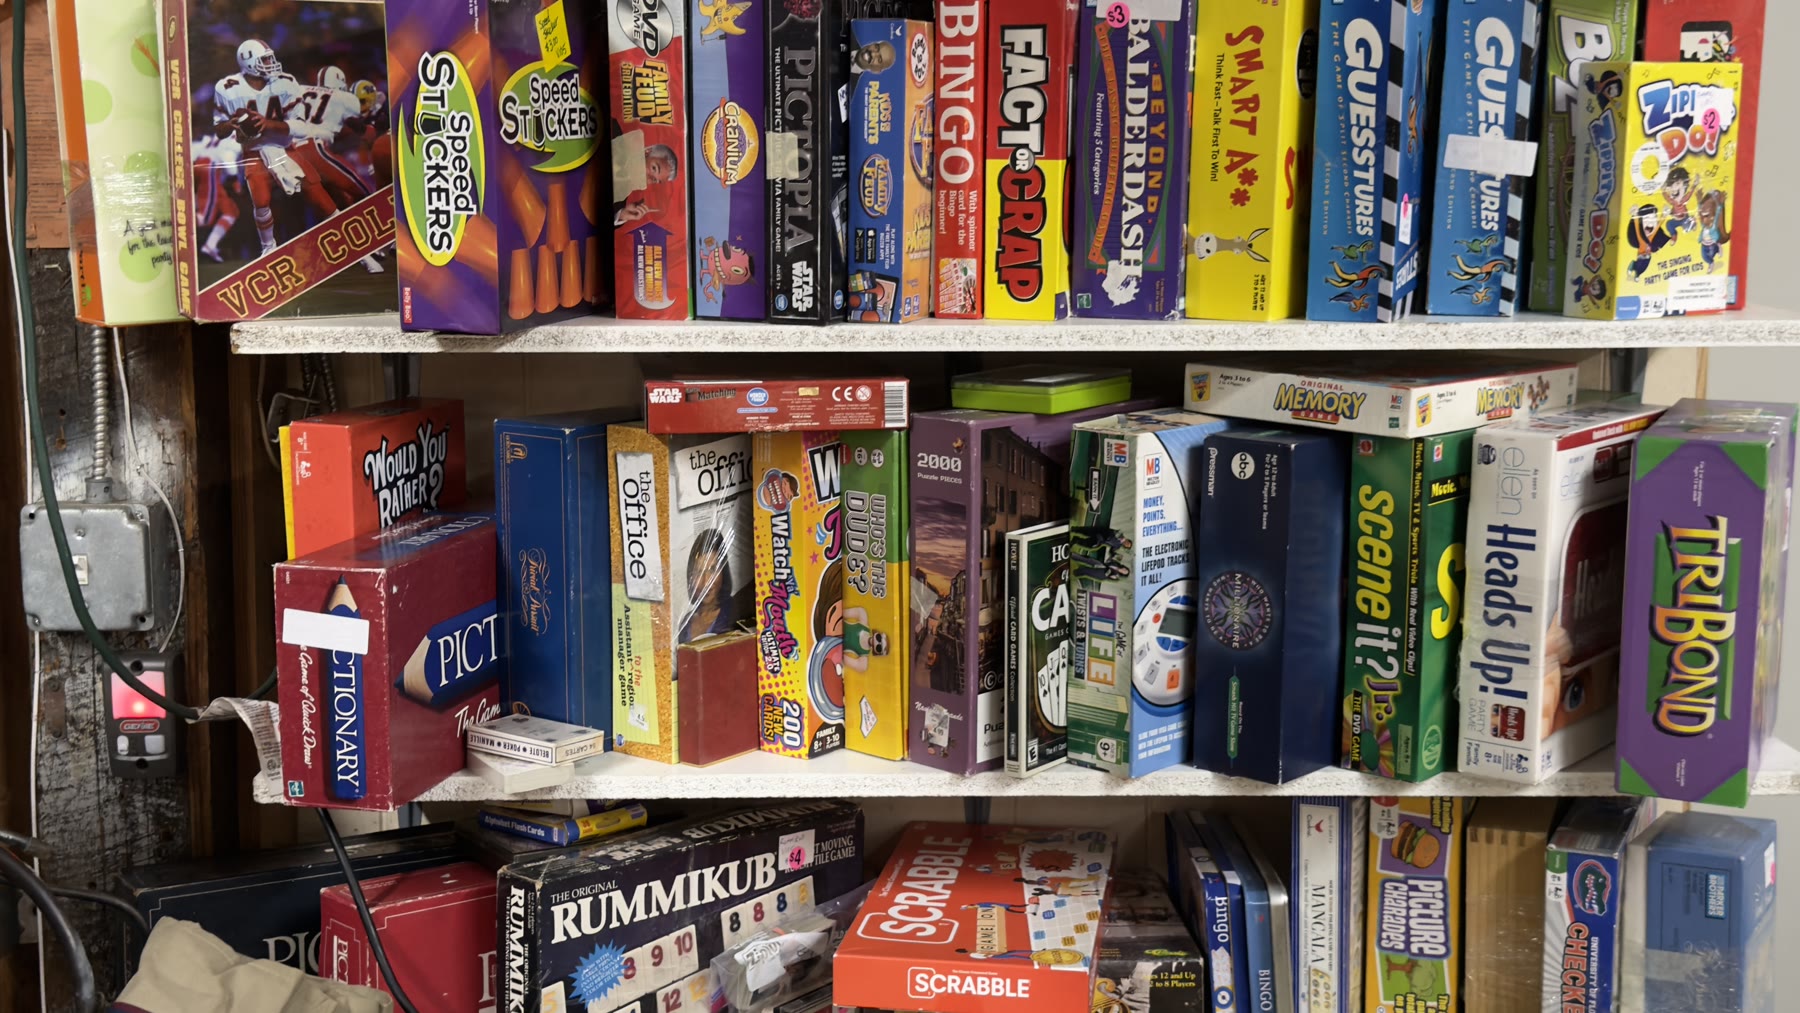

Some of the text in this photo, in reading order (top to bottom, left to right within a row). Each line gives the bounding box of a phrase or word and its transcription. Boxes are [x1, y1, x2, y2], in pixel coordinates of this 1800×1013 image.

[1107, 5, 1126, 24] $3
[774, 47, 782, 64] THE
[530, 75, 579, 112] Speed
[634, 66, 655, 118] FEUD
[645, 60, 673, 126] FAMILY
[774, 66, 782, 106] ULTIMATE
[938, 1, 979, 184] BINGO
[999, 24, 1049, 157] FACT
[1225, 25, 1265, 136] SMART
[868, 81, 879, 145] PARENTS
[1093, 92, 1105, 138] Featuring
[1210, 53, 1224, 182] Think Fast Talk First To Win!
[1343, 17, 1385, 237] GUESSTURES
[1703, 111, 1716, 130] $2
[449, 112, 477, 213] Speed
[784, 47, 818, 251] PICTOPIA
[1015, 150, 1027, 171] OR
[1120, 19, 1151, 278] BALDERDASH
[1147, 73, 1166, 213] BEYOND
[169, 59, 191, 314] VCR COLLEGE BOWL GAME
[863, 166, 878, 208] FEUD
[875, 158, 891, 216] FAMILY
[1092, 147, 1103, 195] Categories
[774, 197, 782, 226] FAMILY
[938, 190, 948, 235] beginner!
[948, 190, 957, 217] Bingo
[958, 190, 967, 245] card for the
[967, 190, 978, 252] With spinner
[998, 164, 1047, 302] CRAP
[216, 206, 396, 319] VCR COL
[792, 261, 805, 312] WARS
[801, 261, 814, 311] STAR
[649, 395, 683, 404] WARS
[650, 387, 681, 396] STAR
[1273, 382, 1367, 420] MEMORY
[1300, 379, 1345, 392] ORIGINAL
[1476, 382, 1525, 416] MEMORY
[364, 445, 418, 493] WOULD
[417, 421, 448, 470] YOU
[689, 449, 717, 471] the
[917, 452, 963, 473] 2000
[1113, 442, 1127, 464] MB
[1145, 457, 1161, 476] MB
[1238, 452, 1250, 479] abc
[377, 463, 445, 528] RATHER?
[640, 470, 652, 505] the
[1501, 445, 1526, 517] ellen
[771, 514, 791, 580] Watch
[845, 490, 869, 594] DUDE?
[1142, 539, 1189, 558] THE ELECTRONIC
[1411, 526, 1420, 555] Sports
[871, 560, 887, 599] THE
[1140, 572, 1162, 587] IT ALL!
[1141, 552, 1190, 573] LIFEPOD TRACKS
[1410, 558, 1419, 584] Trivia
[1076, 592, 1087, 627] TWISTS
[1231, 572, 1243, 649] MILLIONAIRE
[1409, 587, 1418, 606] With
[1409, 607, 1417, 625] Real
[1470, 523, 1537, 701] Heads Up!
[623, 604, 634, 662] Assistant
[764, 582, 797, 659] Mouth
[1089, 595, 1115, 682] LIFE
[1408, 627, 1417, 649] Video
[300, 653, 313, 685] Game
[438, 613, 499, 688] PICT
[616, 618, 627, 708] manager game
[1075, 641, 1085, 674] TURNS
[634, 669, 643, 687] the
[300, 700, 316, 735] Quick
[332, 650, 361, 787] CTIONARY
[455, 702, 475, 738] The
[763, 696, 774, 741] CARDS!
[773, 705, 784, 736] NEW
[783, 700, 802, 748] 200
[815, 726, 837, 739] FAMILY
[1352, 695, 1361, 761] THE DVD GAME
[303, 735, 315, 766] Draw
[527, 826, 545, 837] Cards
[822, 835, 854, 851] MOVING
[789, 848, 802, 866] $4
[550, 880, 618, 903] THE ORIGINAL
[550, 852, 777, 944] RUMMIKUB
[879, 835, 973, 938] SCRABBLE
[1213, 896, 1229, 943] Bingo
[1311, 883, 1326, 965] MANCALA
[651, 945, 664, 967] 9
[674, 931, 694, 956] 10
[1589, 936, 1599, 987] UNIVERSITY
[914, 972, 1030, 999] SCRABBLE
[1170, 972, 1184, 980] and
[1184, 971, 1197, 981] Up
[1171, 980, 1197, 989] Players
[1258, 968, 1271, 1013] BINGO
